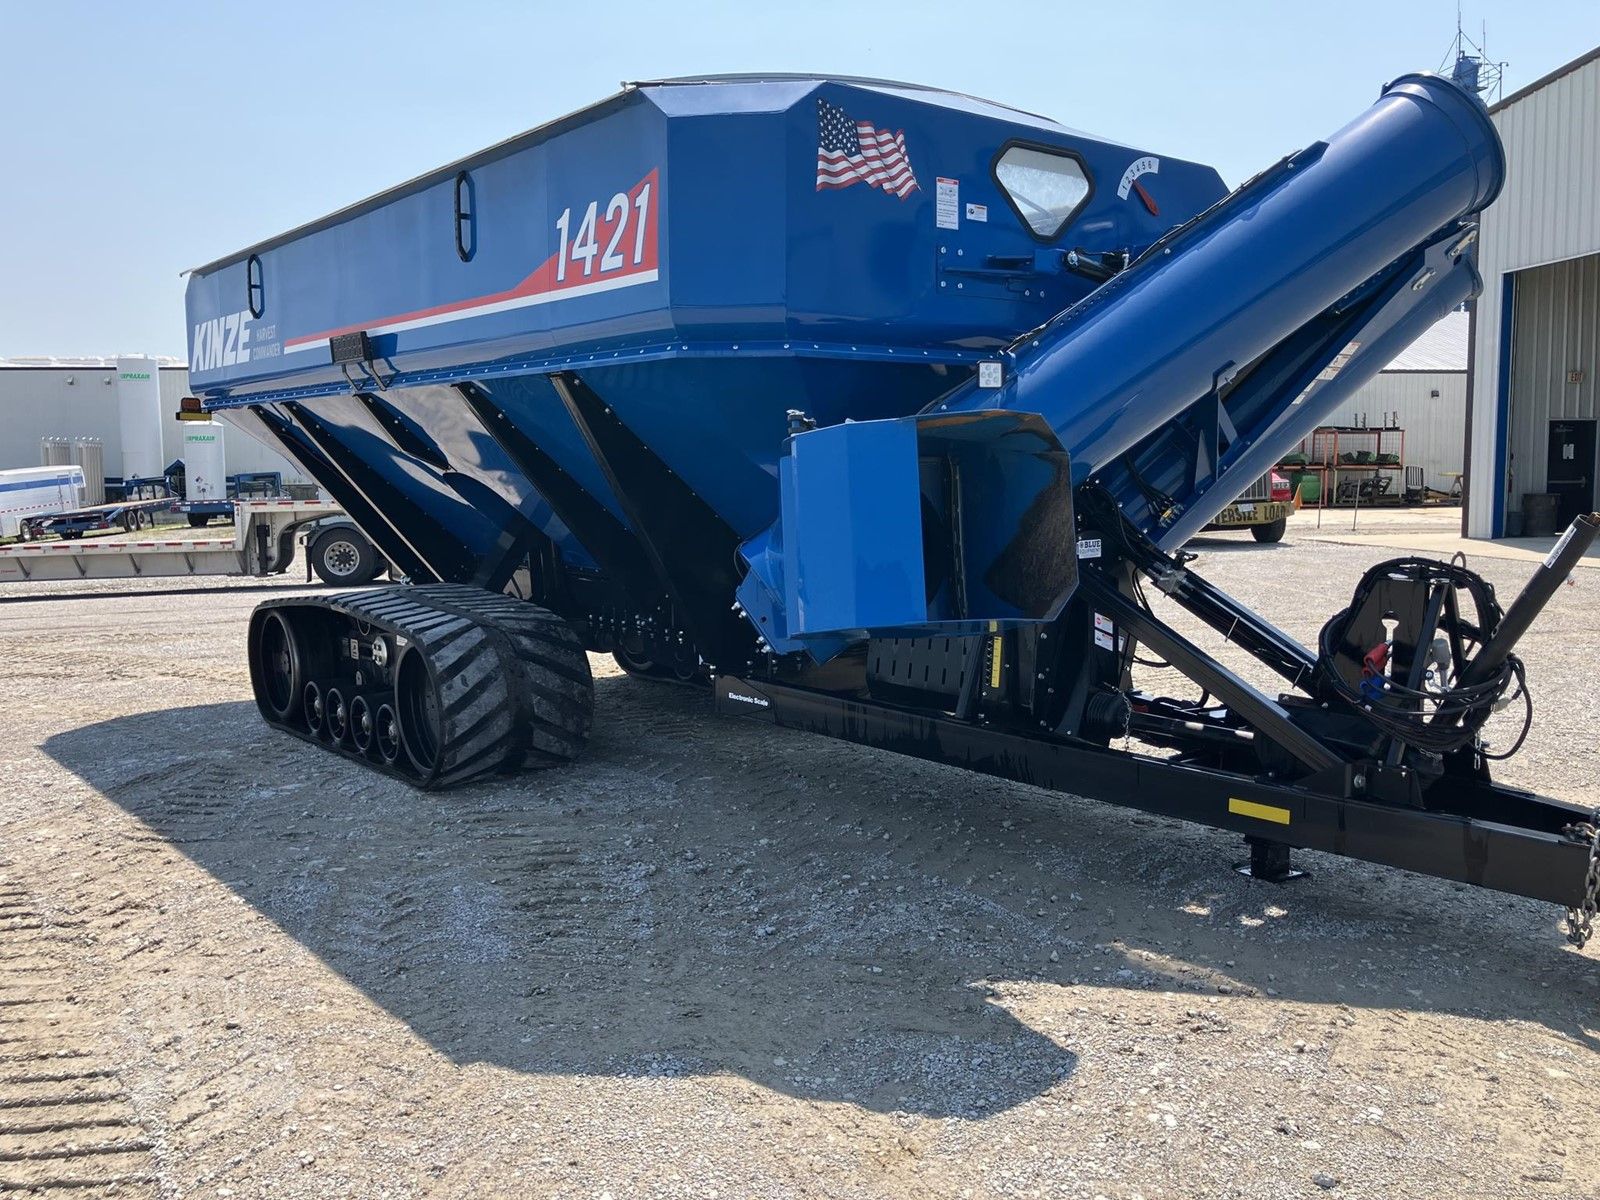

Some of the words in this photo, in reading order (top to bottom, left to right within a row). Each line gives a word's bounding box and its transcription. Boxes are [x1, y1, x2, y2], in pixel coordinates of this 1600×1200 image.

[556, 184, 650, 281] 1421
[191, 310, 253, 373] KINZE
[256, 325, 275, 341] HARVEST
[1211, 507, 1258, 524] VERSIZE
[1264, 505, 1286, 520] LOAD
[1084, 540, 1101, 548] BLUE
[729, 692, 753, 703] Electronic
[754, 698, 768, 706] Scale
